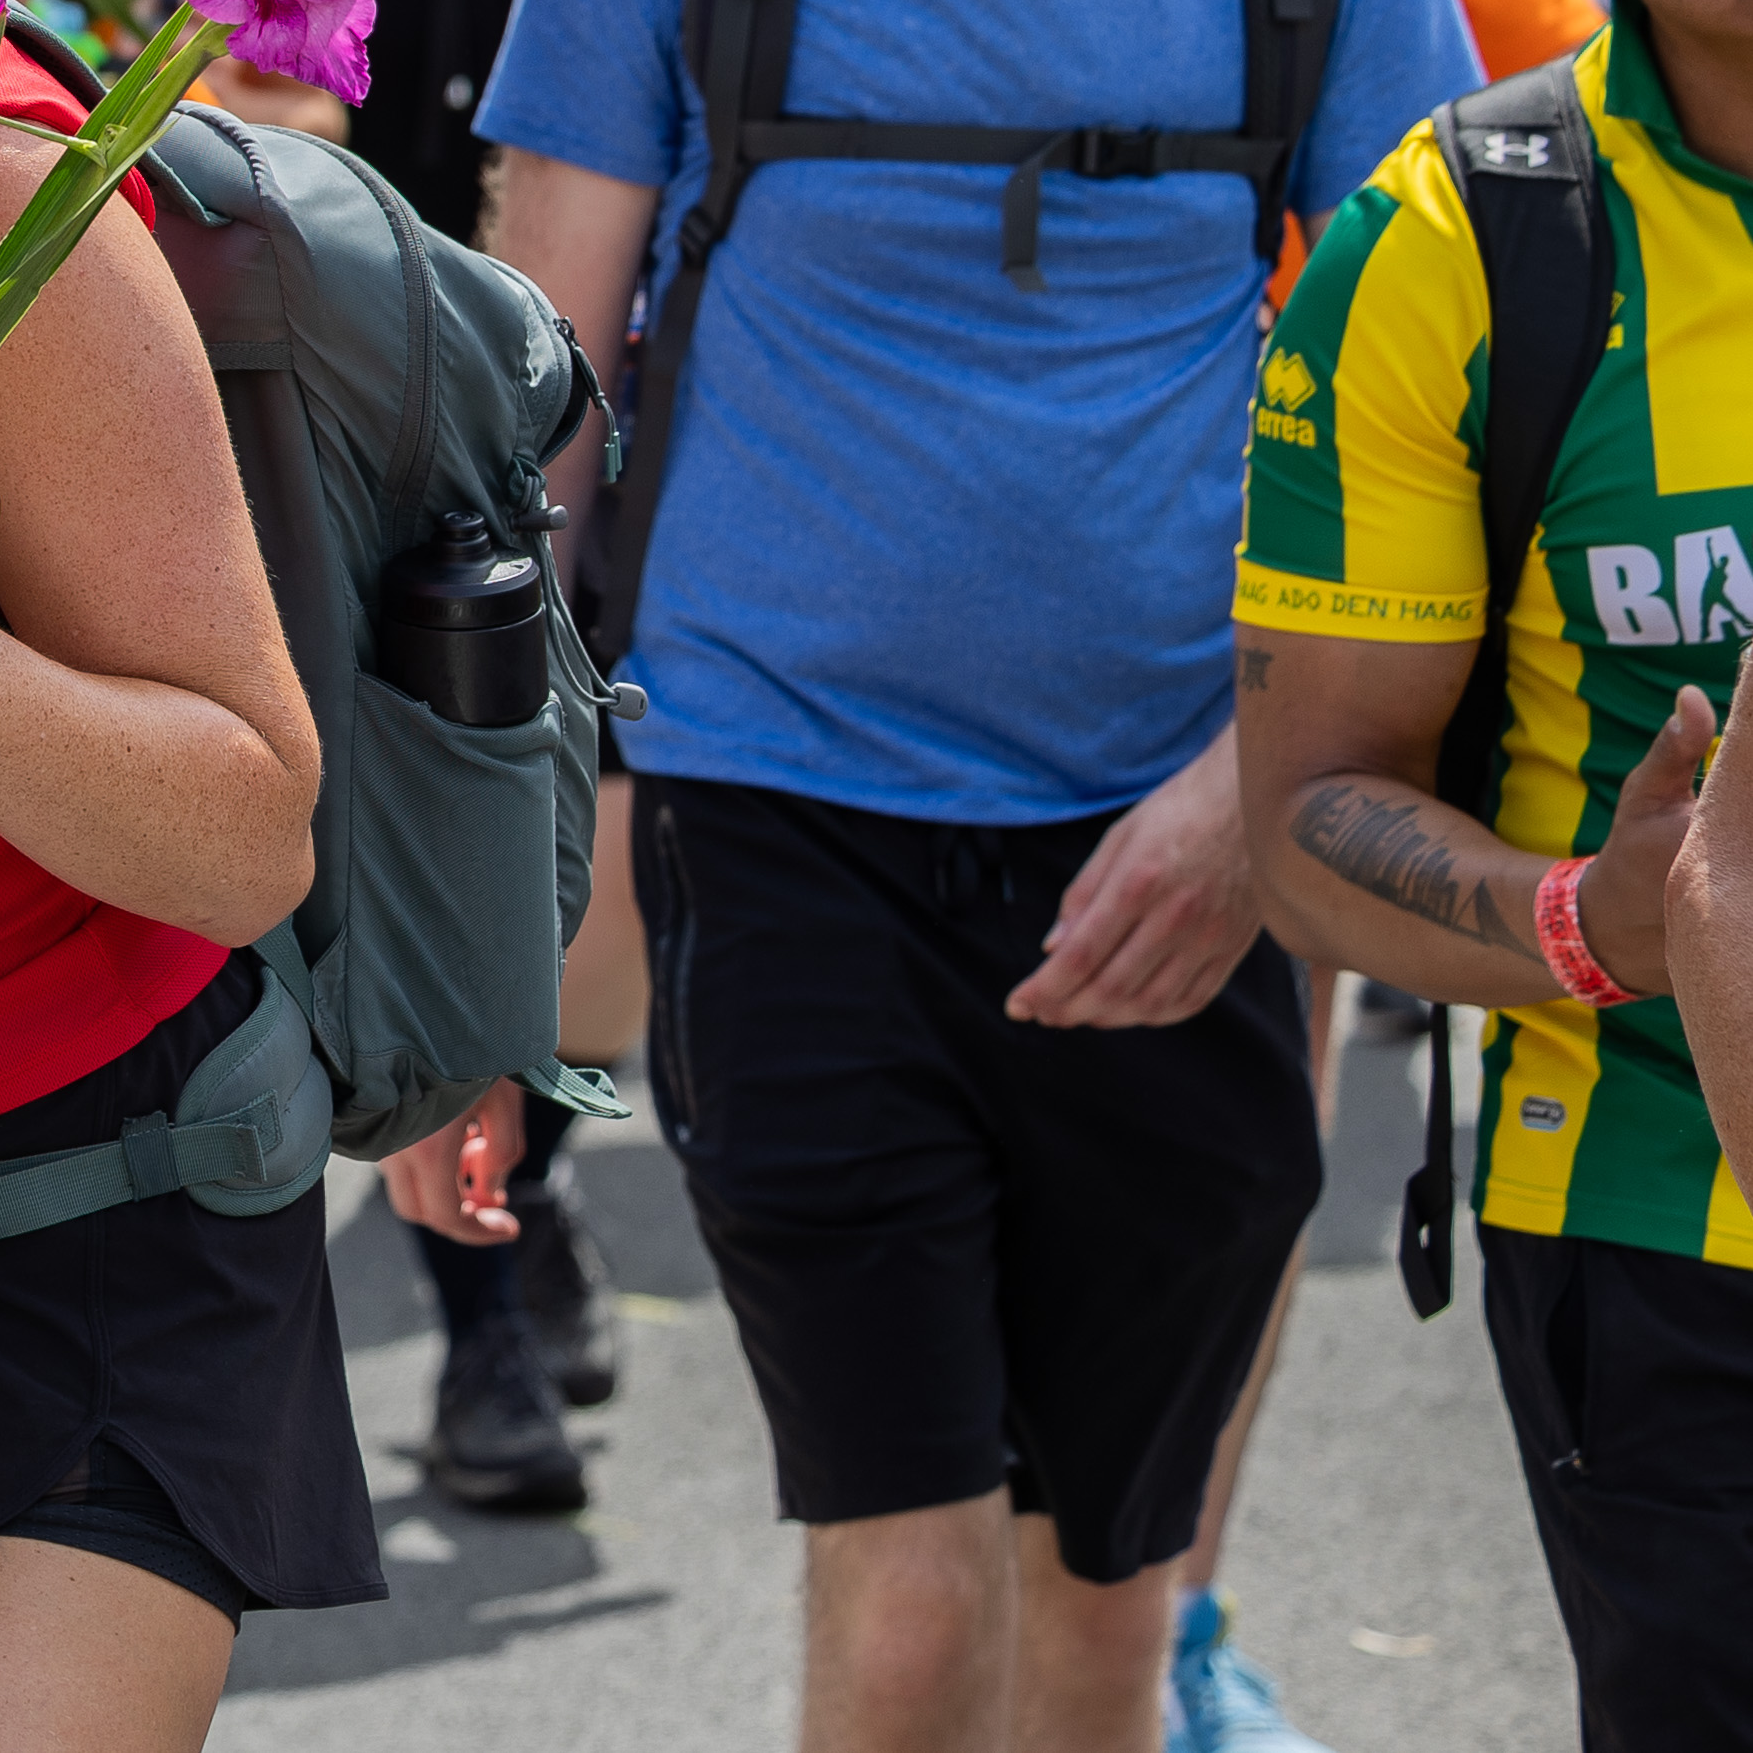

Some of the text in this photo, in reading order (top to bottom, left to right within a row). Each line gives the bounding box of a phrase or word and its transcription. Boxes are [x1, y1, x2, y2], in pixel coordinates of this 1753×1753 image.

[1276, 587, 1322, 613] ADO
[1331, 592, 1389, 619] DEN
[1399, 598, 1476, 622] HAAG
